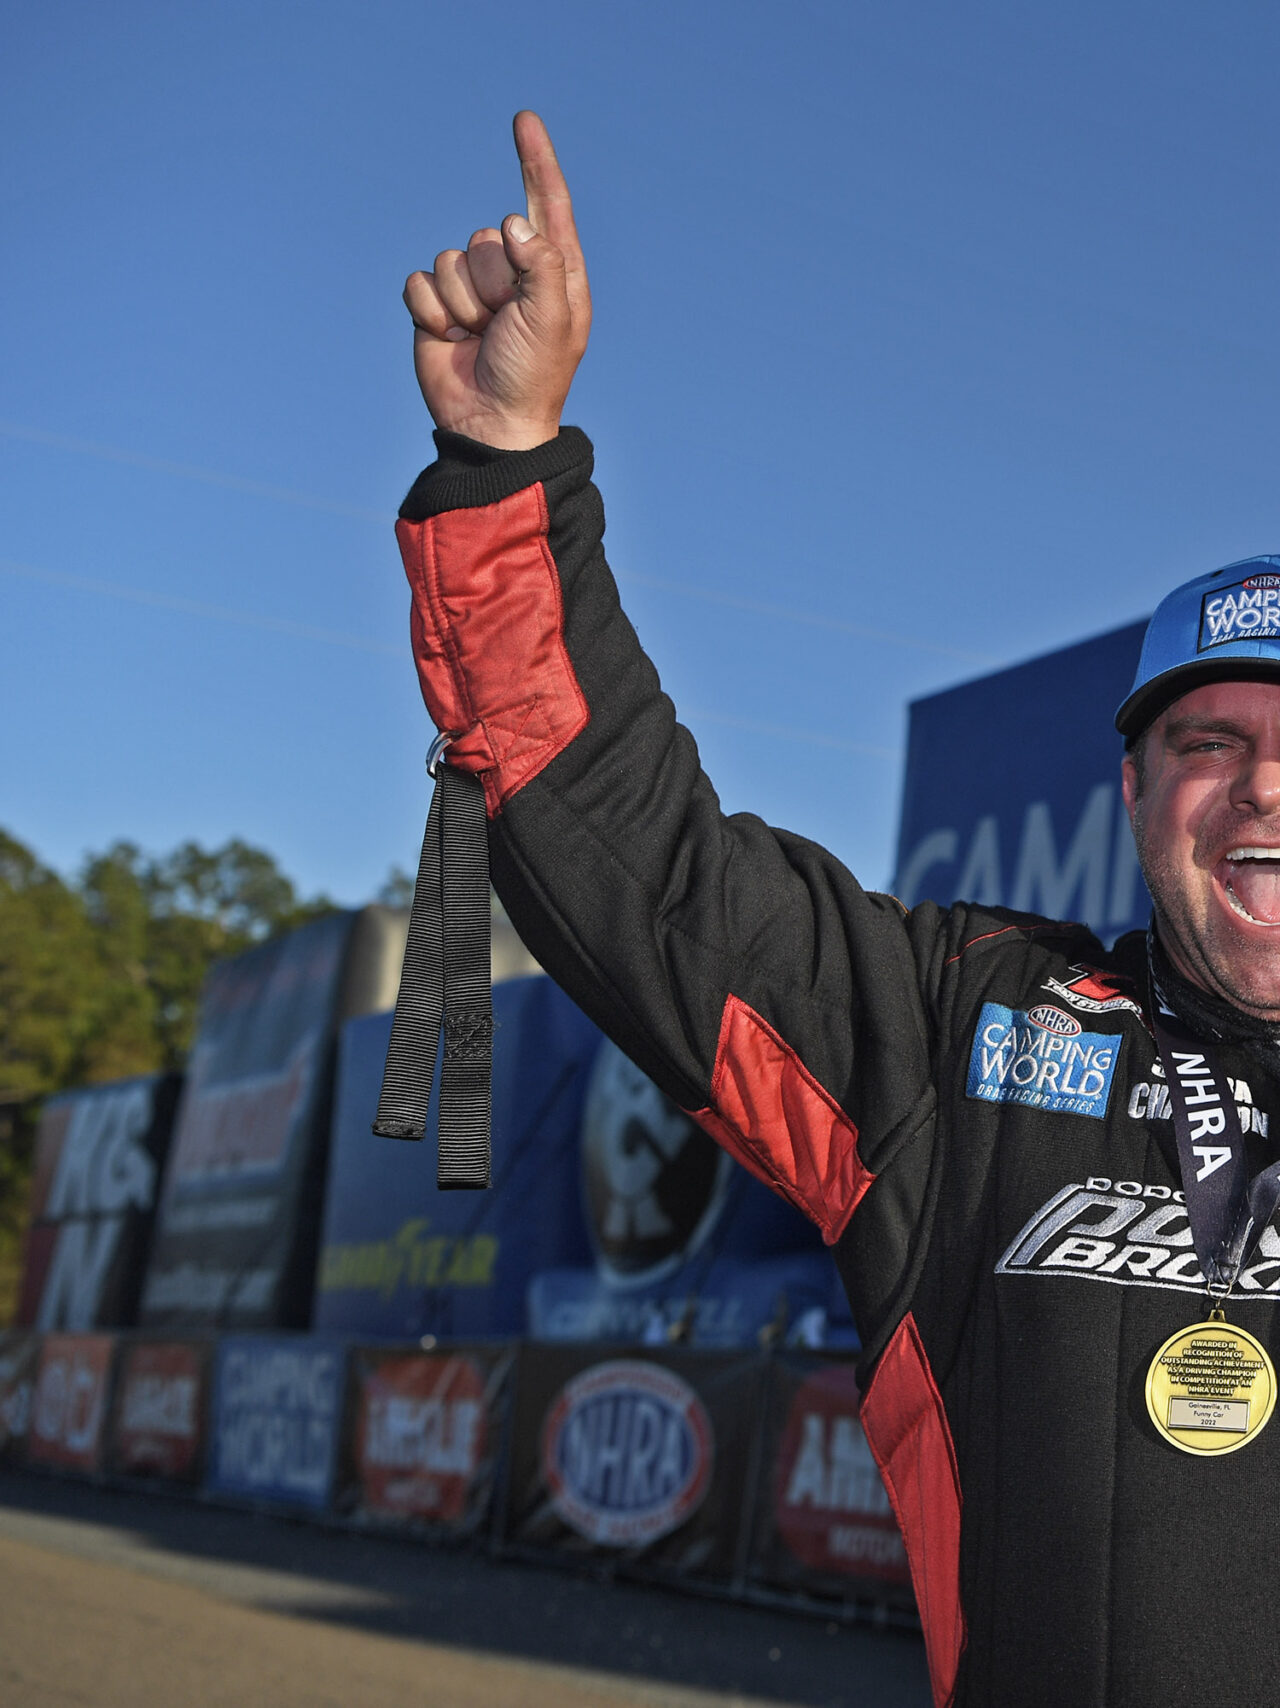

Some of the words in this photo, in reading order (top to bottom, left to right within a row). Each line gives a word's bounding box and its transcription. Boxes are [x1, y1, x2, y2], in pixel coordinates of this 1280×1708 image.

[1036, 1008, 1073, 1032] NHRA
[983, 1023, 1112, 1070] CAMPING
[981, 1047, 1105, 1096] WORLD
[1053, 1097, 1096, 1112] SERIES
[1171, 1051, 1233, 1182] NHRA
[1191, 1340, 1228, 1349] AWARDED
[1183, 1349, 1232, 1358] RECOGNITION
[1233, 1351, 1244, 1359] OF
[1161, 1357, 1212, 1367] OUTSTANDING
[1213, 1359, 1265, 1369] ACHIEVEMENT
[1185, 1368, 1216, 1377] DRIVING
[1217, 1369, 1257, 1378] CHAMPION
[1180, 1376, 1230, 1386] COMPETITION
[1188, 1386, 1210, 1395] NHRA
[1210, 1387, 1235, 1396] EVENT
[1193, 1411, 1212, 1419] Funny
[563, 1396, 689, 1508] NHRA
